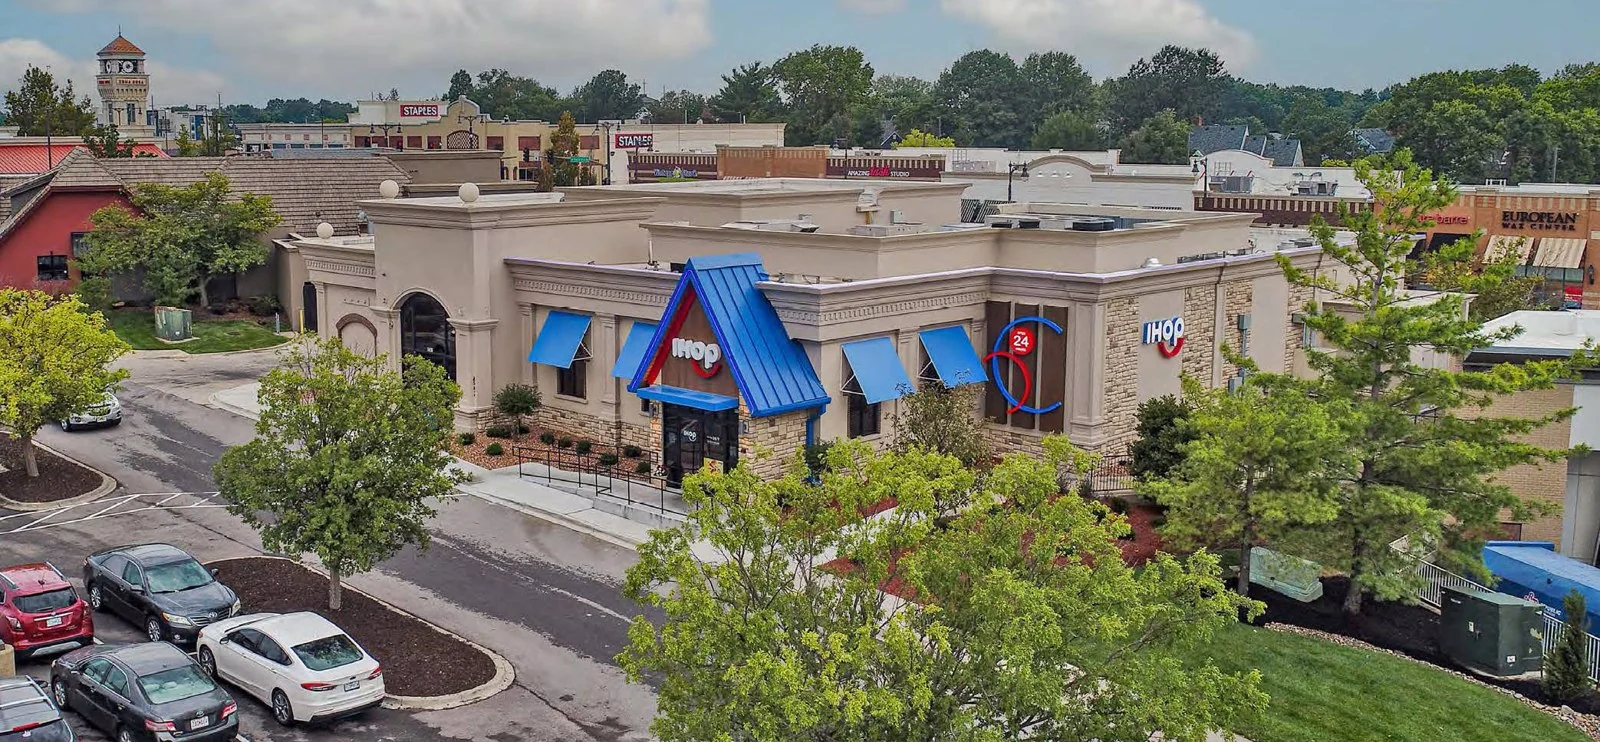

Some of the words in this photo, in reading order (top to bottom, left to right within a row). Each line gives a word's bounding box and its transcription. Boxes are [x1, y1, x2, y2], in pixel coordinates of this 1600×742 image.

[403, 106, 437, 116] STAPLES
[618, 135, 653, 147] STAPLES
[1502, 211, 1577, 223] EUROPEAN
[1530, 223, 1575, 231] CENTER
[1013, 335, 1029, 347] 24
